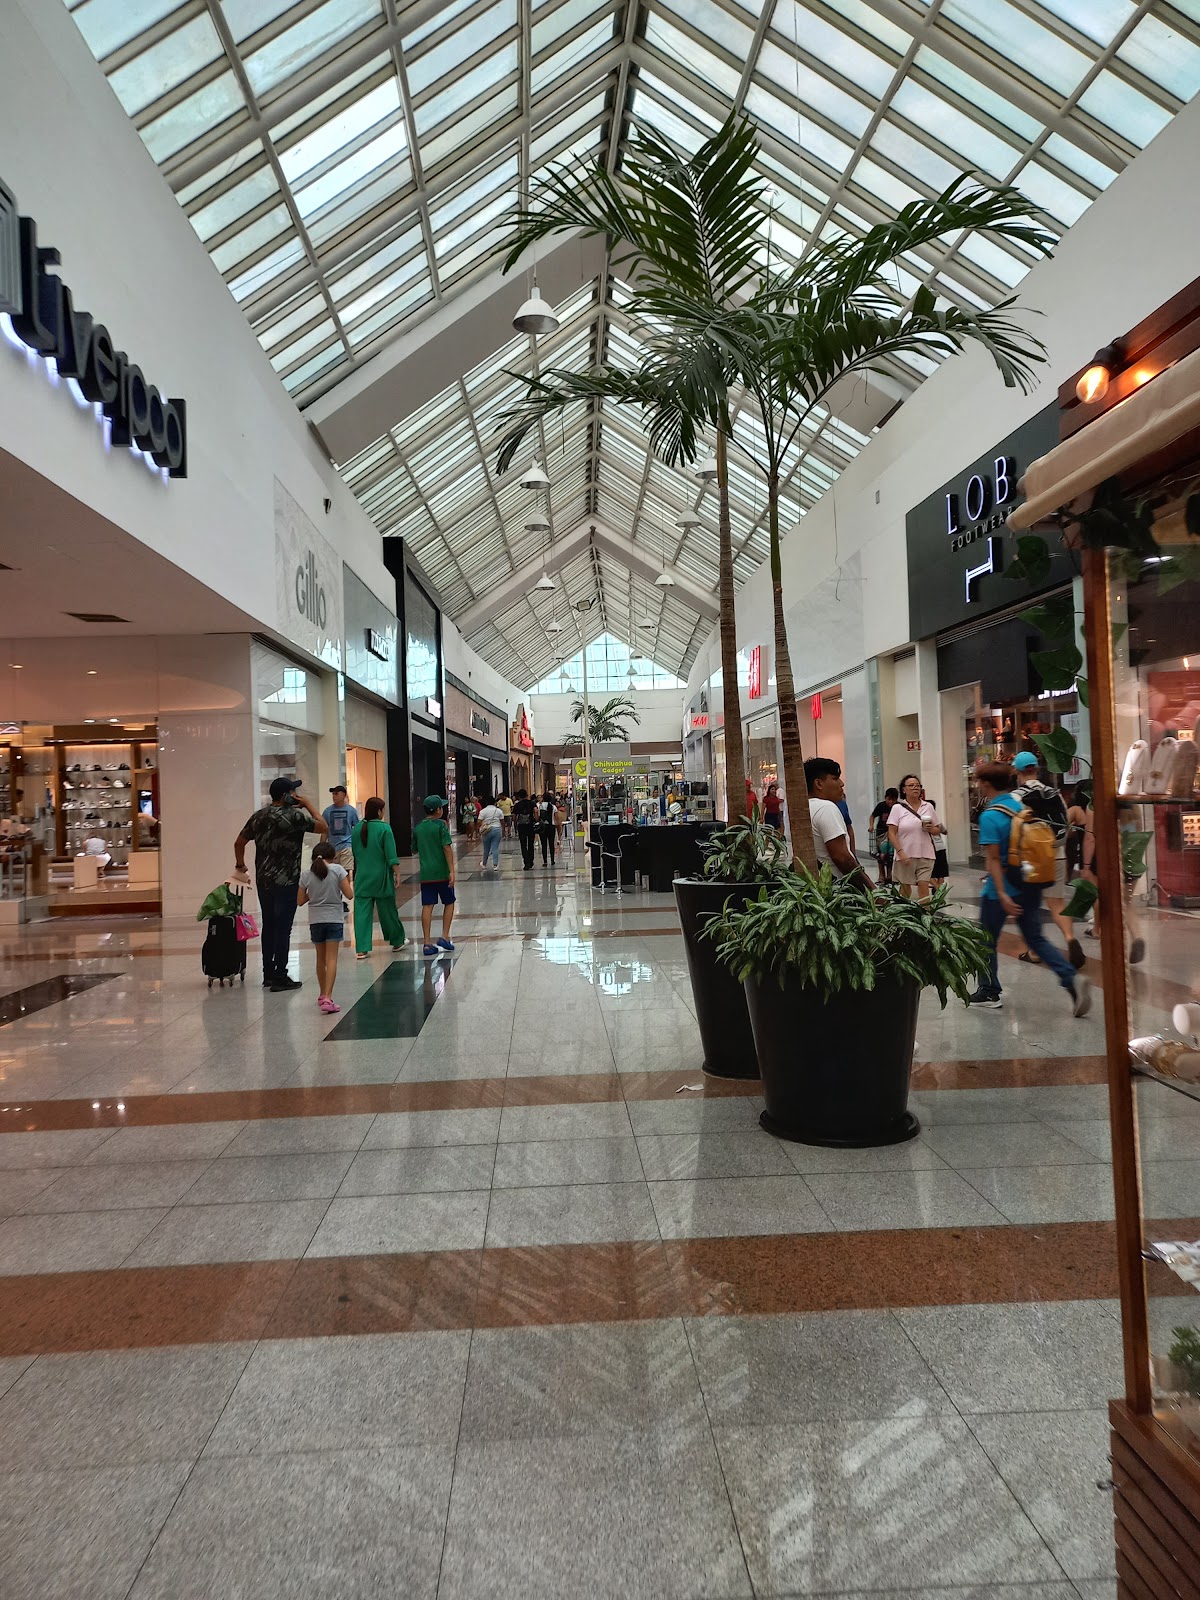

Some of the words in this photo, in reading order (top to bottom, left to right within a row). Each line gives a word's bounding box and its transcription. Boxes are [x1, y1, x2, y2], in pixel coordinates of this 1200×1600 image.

[11, 214, 188, 479] Liverpool
[945, 455, 1012, 535] LOB
[295, 549, 327, 631] Gillio
[593, 760, 633, 768] Chihuahua
